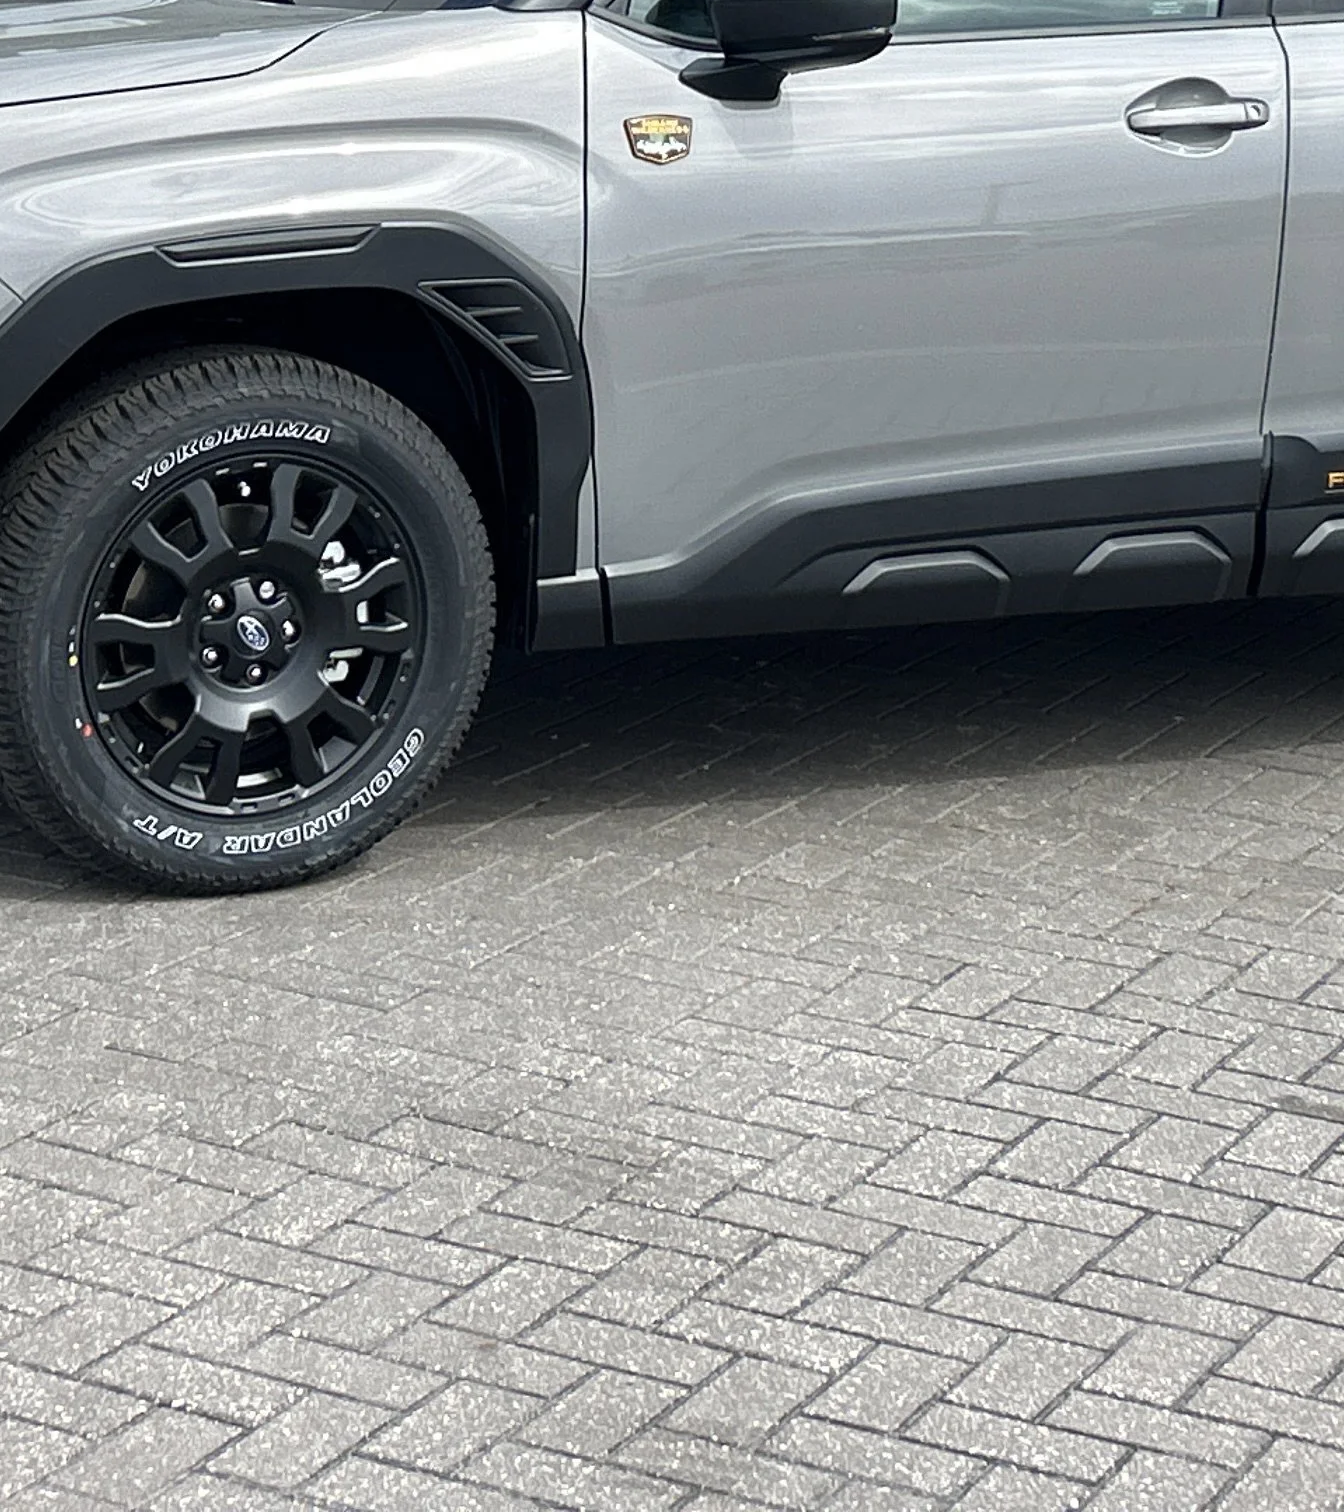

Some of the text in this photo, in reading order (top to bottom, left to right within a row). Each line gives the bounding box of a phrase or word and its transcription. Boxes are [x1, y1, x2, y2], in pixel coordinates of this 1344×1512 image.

[131, 419, 331, 491] YOKOHAMA
[133, 727, 425, 854] GEOLANDAR A/T
